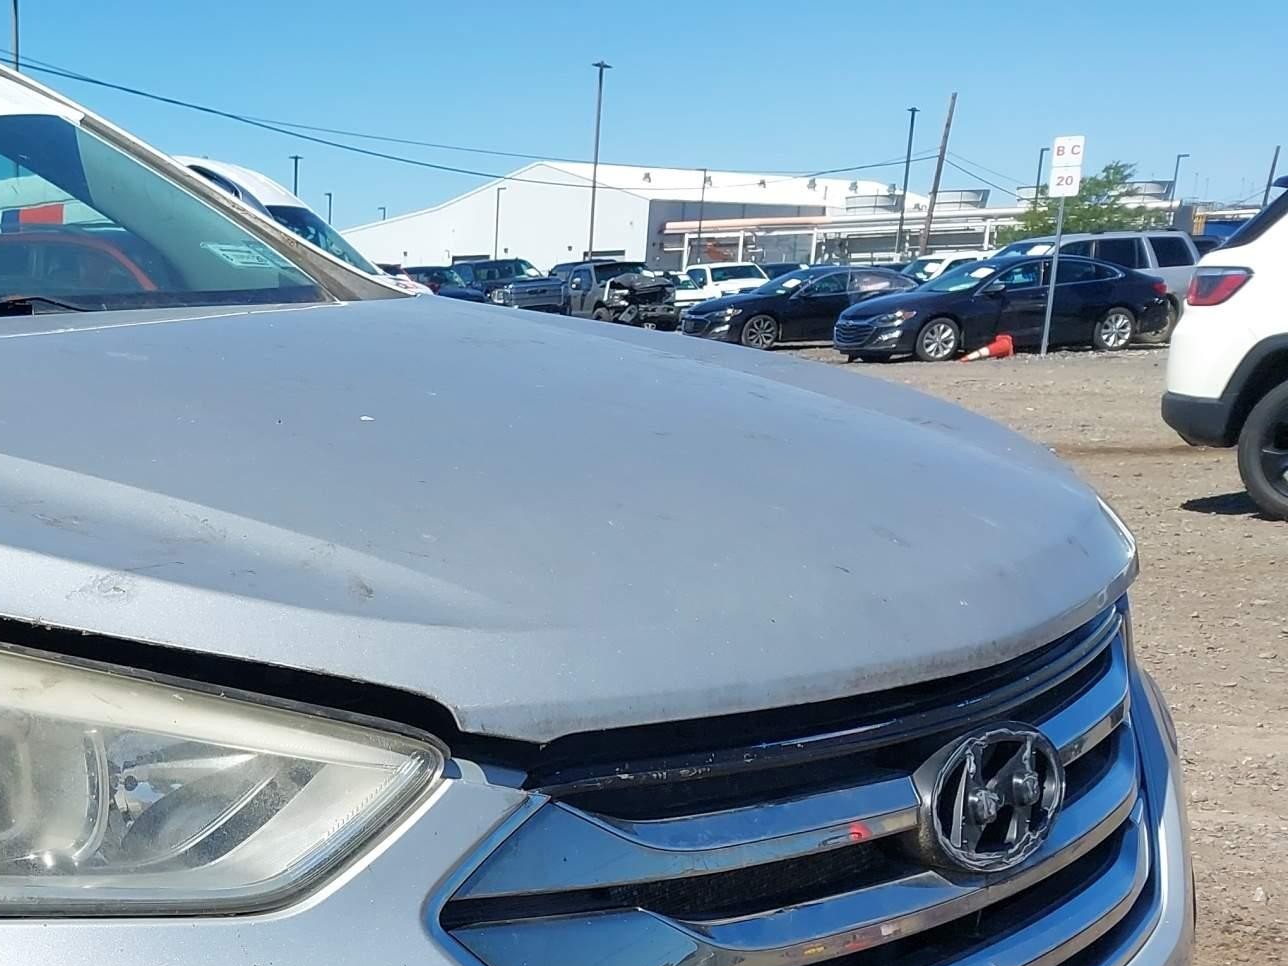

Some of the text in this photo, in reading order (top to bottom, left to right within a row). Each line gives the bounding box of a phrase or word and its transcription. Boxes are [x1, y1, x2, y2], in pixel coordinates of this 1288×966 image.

[1056, 144, 1081, 157] B C
[1055, 175, 1074, 187] 20
